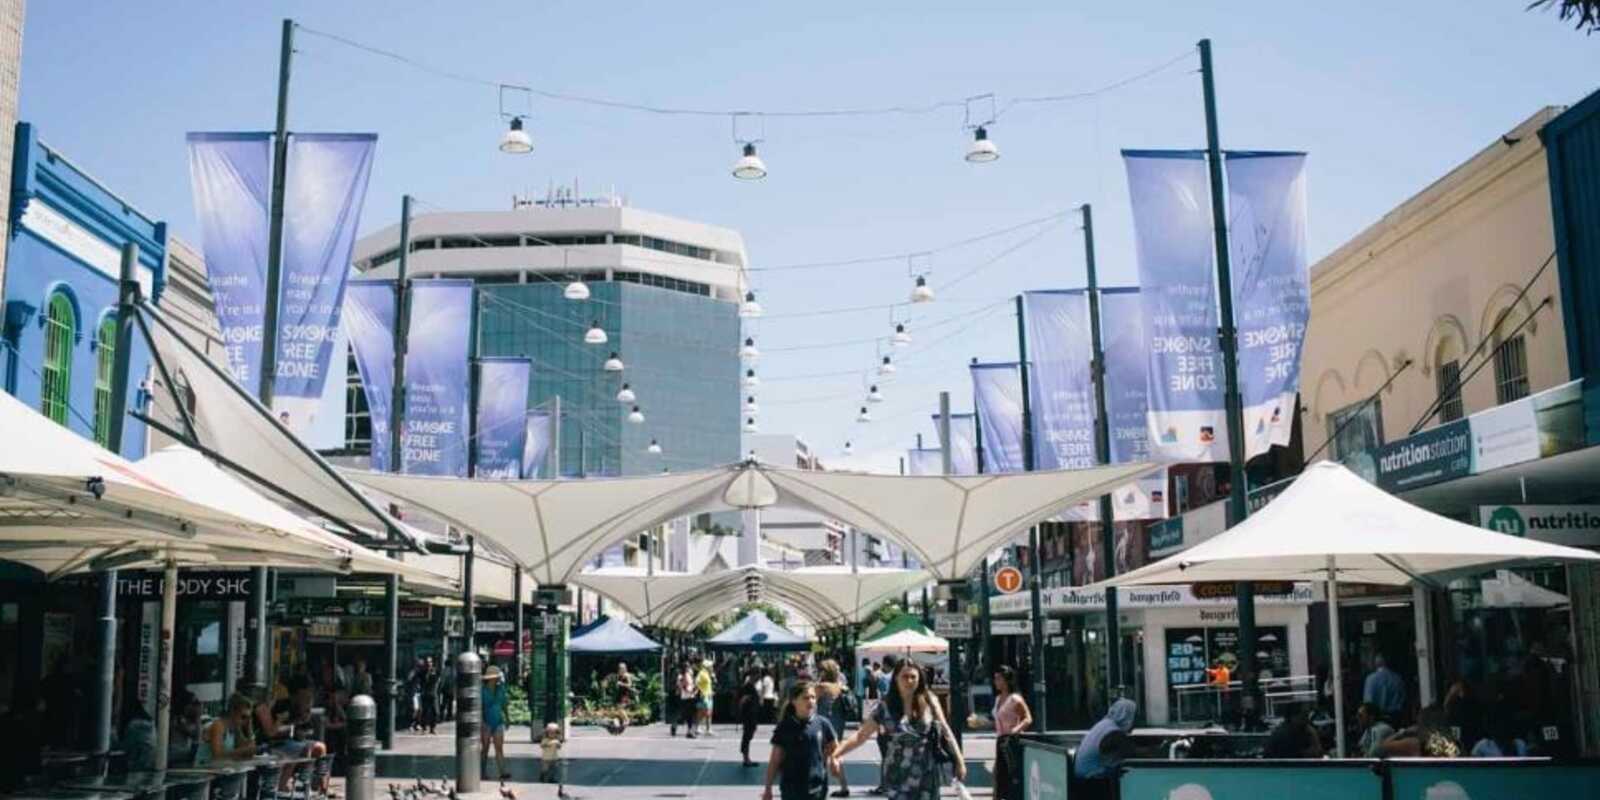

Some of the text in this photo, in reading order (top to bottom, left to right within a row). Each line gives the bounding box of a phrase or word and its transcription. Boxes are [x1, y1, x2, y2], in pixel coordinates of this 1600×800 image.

[281, 324, 339, 342] SMOKE
[276, 361, 320, 378] ZONE
[408, 420, 457, 434] SMOKE
[407, 434, 437, 448] FREE
[404, 449, 441, 462] ZONE
[117, 578, 153, 595] THE
[215, 577, 250, 595] SHO
[1171, 671, 1204, 683] OFF
